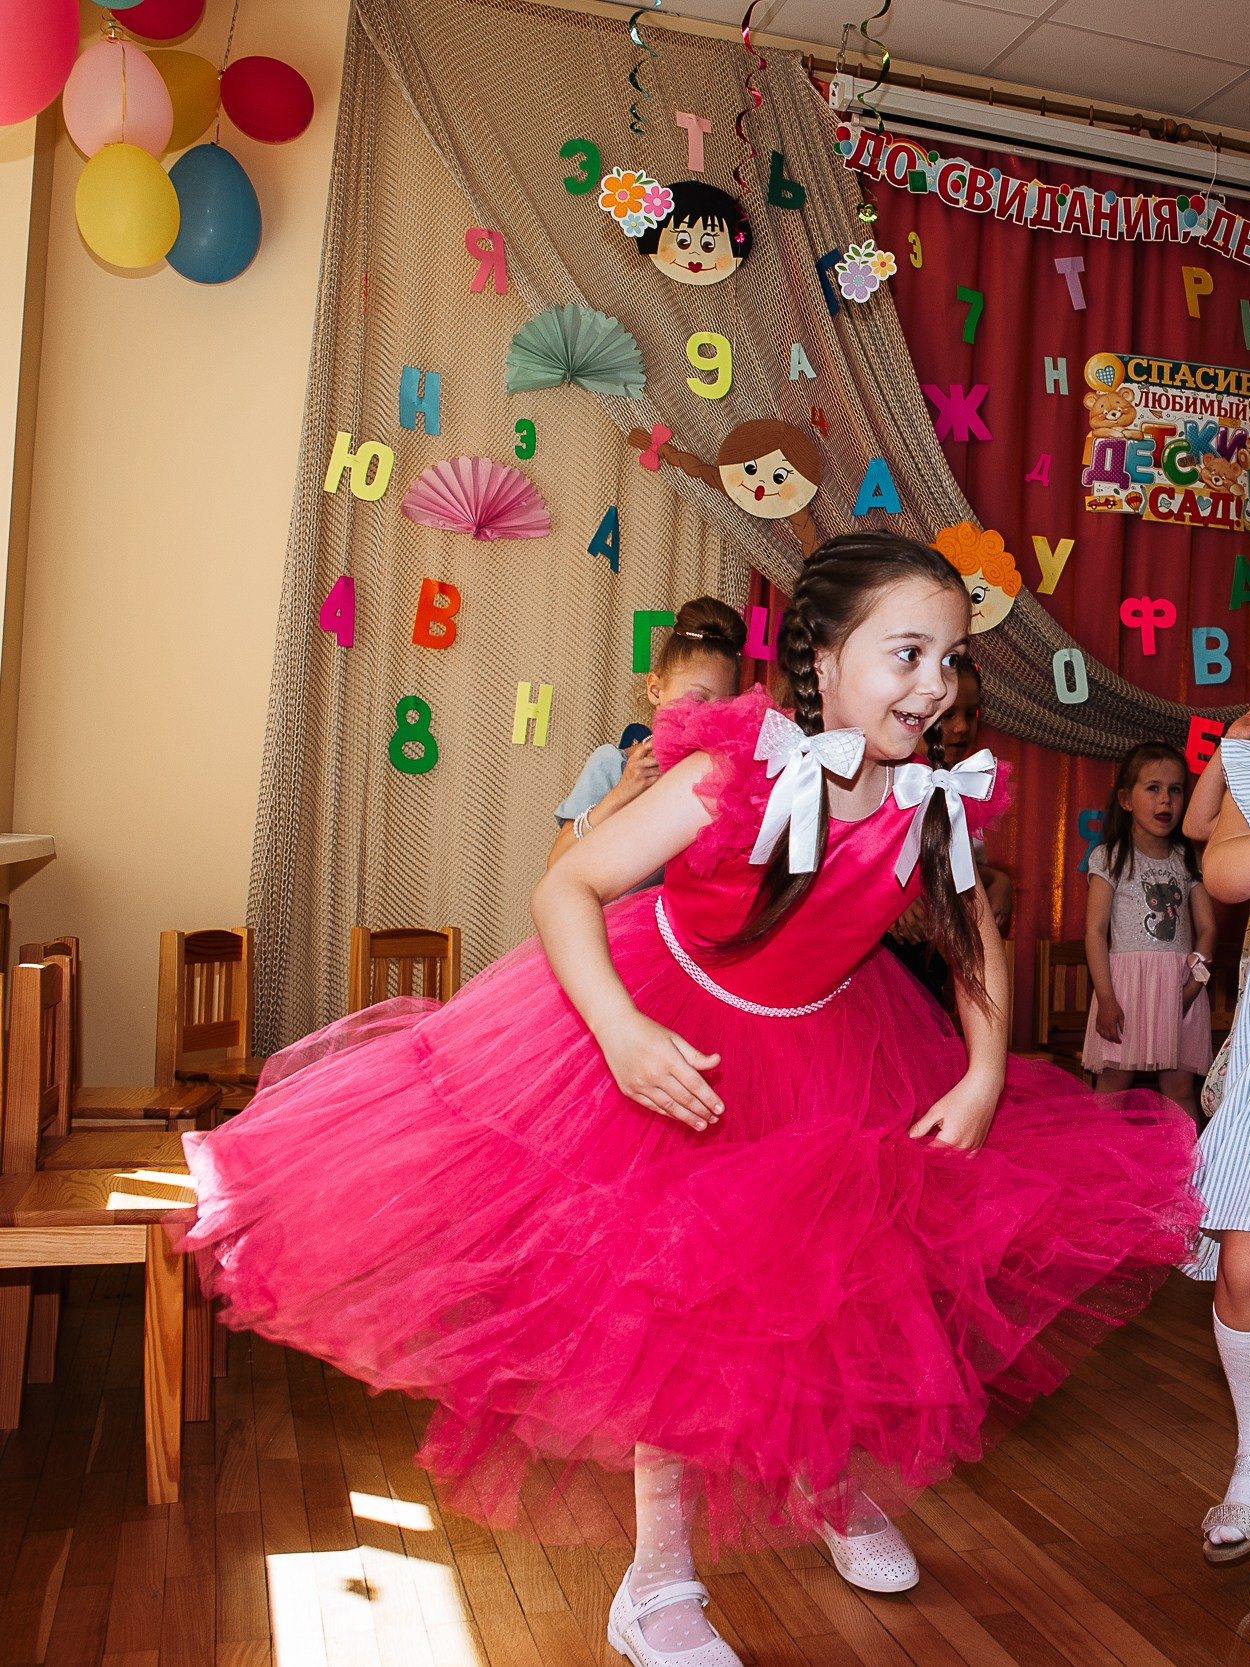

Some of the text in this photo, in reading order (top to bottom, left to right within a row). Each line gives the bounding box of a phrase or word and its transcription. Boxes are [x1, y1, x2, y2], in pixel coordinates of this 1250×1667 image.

[676, 111, 712, 172] Т
[845, 130, 917, 188] ДО
[937, 162, 1192, 242] СВИДАНИЯ,
[465, 228, 507, 294] Я
[1054, 256, 1086, 310] Т
[957, 285, 984, 344] 7
[1181, 266, 1213, 318] Р
[686, 332, 732, 399] 9
[790, 343, 816, 381] А
[1044, 356, 1068, 395] Н
[400, 365, 441, 436] Н
[920, 384, 994, 442] Ж
[1135, 390, 1247, 421] ЛЮБИМЫЙ
[324, 432, 394, 501] Ю
[853, 457, 902, 516] А
[1025, 454, 1052, 487] Д
[1149, 485, 1243, 528] САД!
[587, 505, 620, 572] А
[412, 578, 461, 648] В
[1120, 596, 1177, 655] Ф
[1191, 626, 1232, 685] В
[389, 695, 438, 774] 8
[512, 681, 552, 746] Н
[1185, 715, 1225, 775] Е
